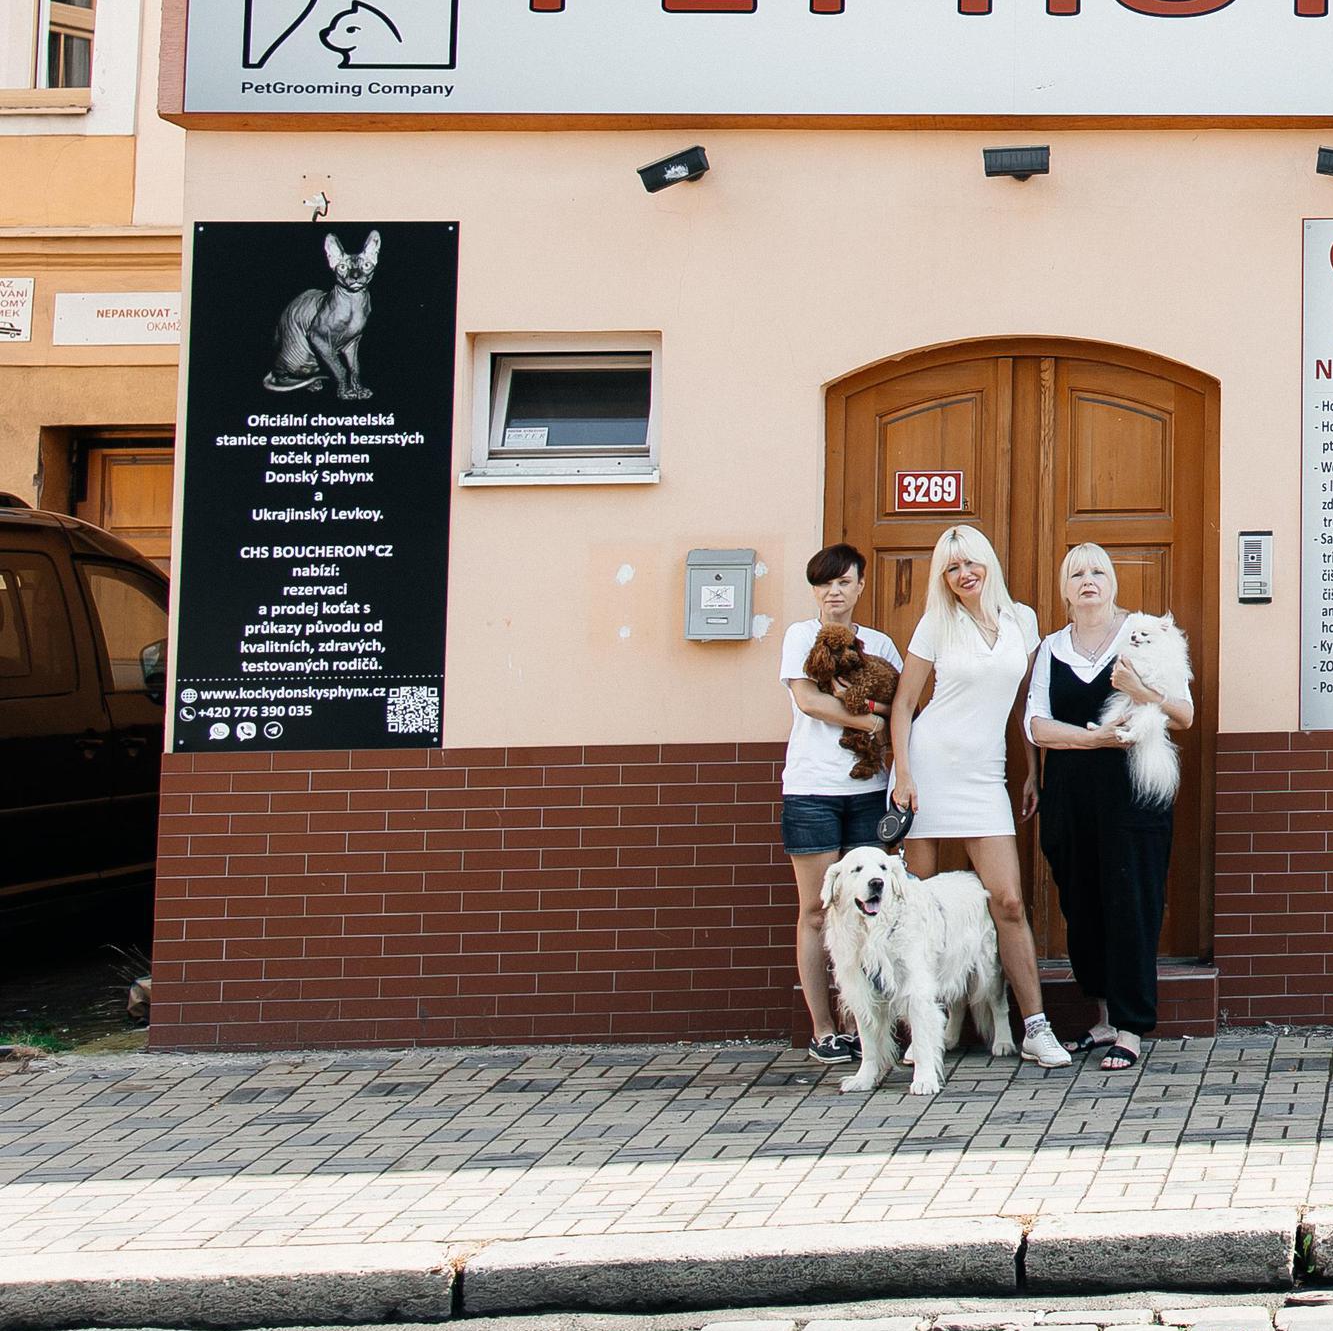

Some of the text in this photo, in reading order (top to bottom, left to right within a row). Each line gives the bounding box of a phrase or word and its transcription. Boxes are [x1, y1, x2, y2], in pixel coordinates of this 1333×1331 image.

[241, 82, 455, 98] PetGrooming Company
[96, 308, 171, 318] NEPARKOVAT
[247, 412, 394, 427] Oficiální chovatelská
[215, 431, 424, 447] stanice exotických bezsrstých
[269, 450, 369, 466] koček plemen
[265, 469, 373, 485] Donský Sphynx
[903, 476, 957, 503] 3269
[1321, 482, 1327, 492] s
[313, 491, 323, 501] a
[252, 506, 383, 523] Ukrajinský Levkoy.
[240, 546, 269, 558] CHS
[292, 563, 339, 577] nabízí:
[283, 582, 347, 596] rezervaci
[258, 600, 371, 617] a prodej koťat s
[244, 619, 382, 637] průkazy původu od
[239, 638, 385, 654] kvalitních, zdravých,
[241, 656, 382, 674] testovaných rodičů.
[199, 685, 387, 701] www.kockydonskysphynx.cz
[197, 705, 312, 718] +420 776 390 035
